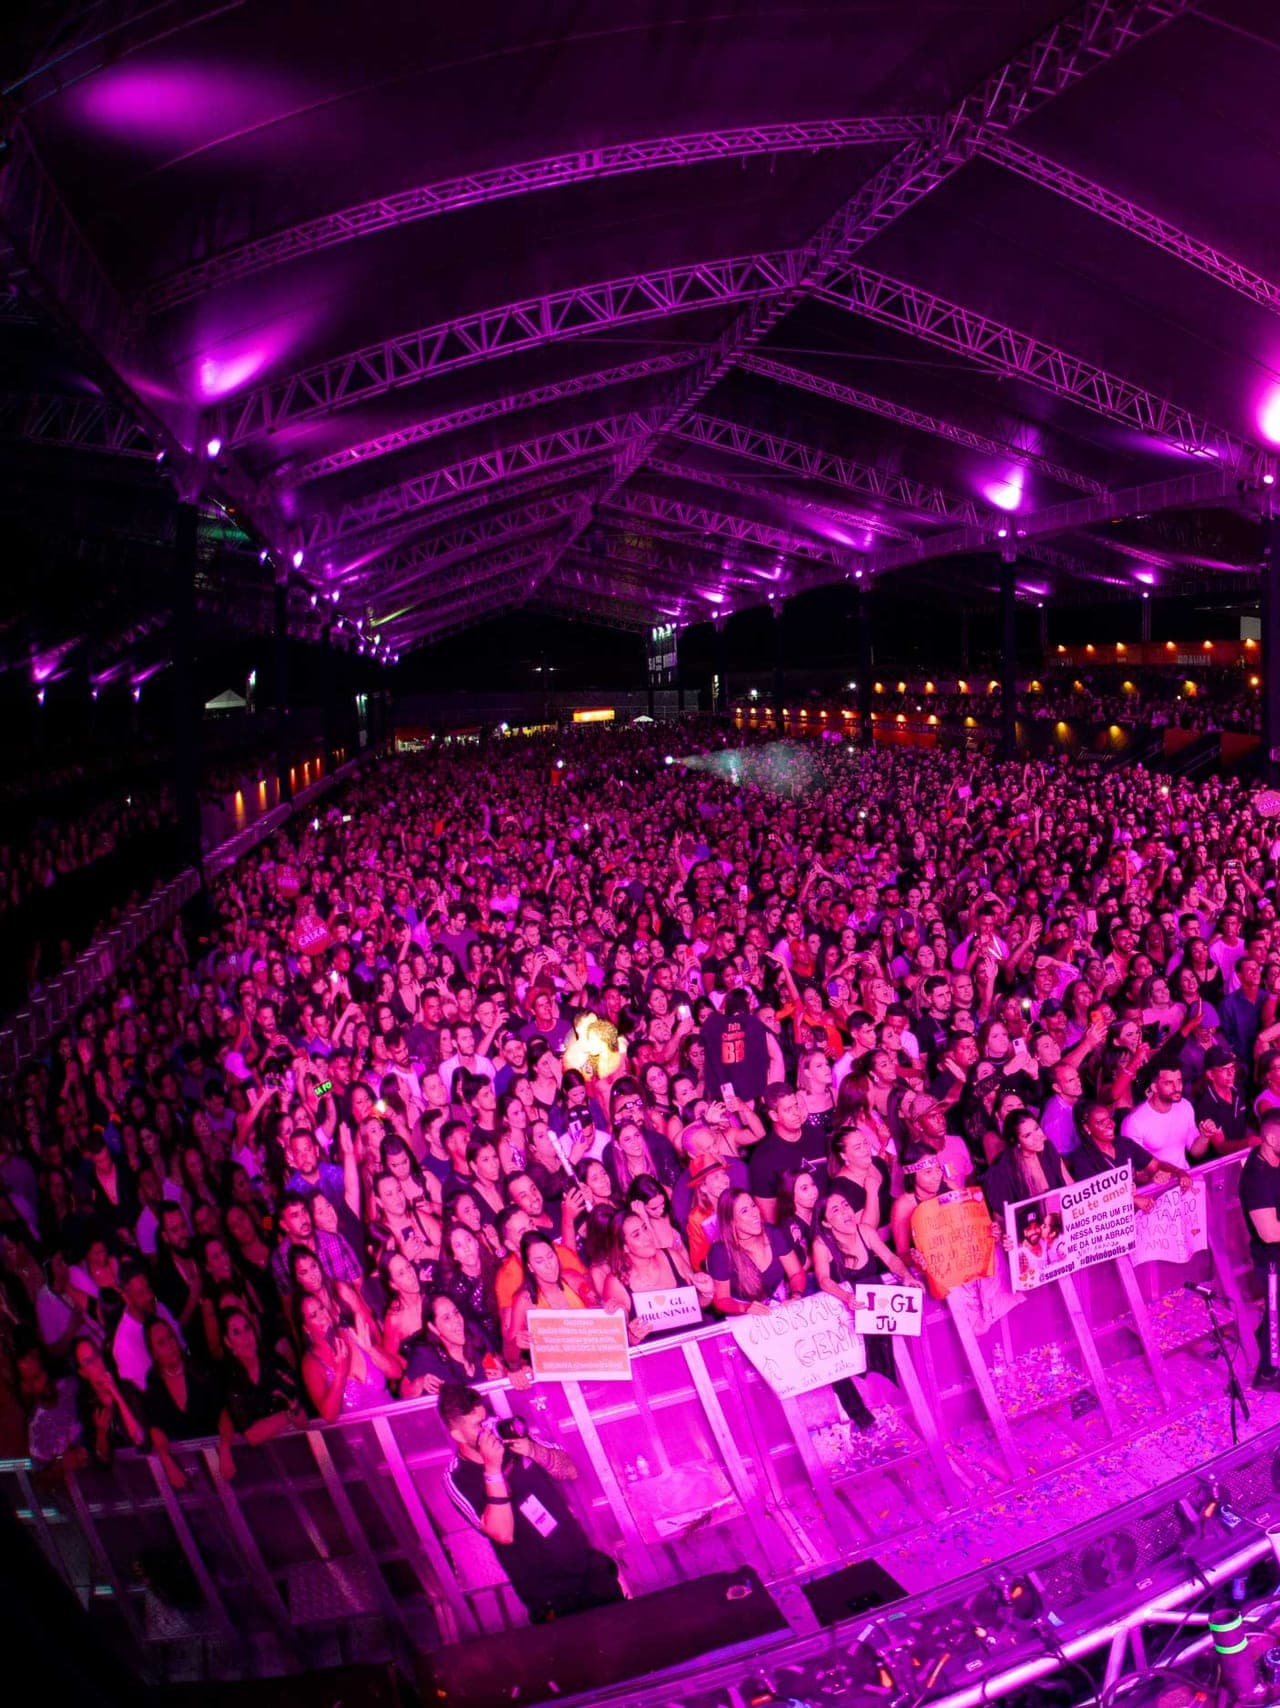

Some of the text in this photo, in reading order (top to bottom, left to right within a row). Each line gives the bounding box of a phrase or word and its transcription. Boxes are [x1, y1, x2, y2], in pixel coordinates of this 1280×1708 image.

[298, 927, 327, 946] CAIXA
[1061, 1168, 1130, 1210] Gusttavo
[1071, 1183, 1129, 1220] Eu te amo!
[1065, 1217, 1090, 1232] VAMOS
[1092, 1211, 1108, 1223] POR
[1109, 1207, 1121, 1218] UM
[1067, 1244, 1078, 1254] ME
[1091, 1235, 1103, 1246] UM
[1105, 1224, 1135, 1241] ABRAÇO
[1070, 1227, 1094, 1242] NESSA
[1080, 1239, 1136, 1265] #Divinópolis-M
[647, 1300, 653, 1310] I
[866, 1292, 876, 1311] I
[641, 1305, 697, 1322] BRUNINHA
[876, 1315, 897, 1332] JÚ
